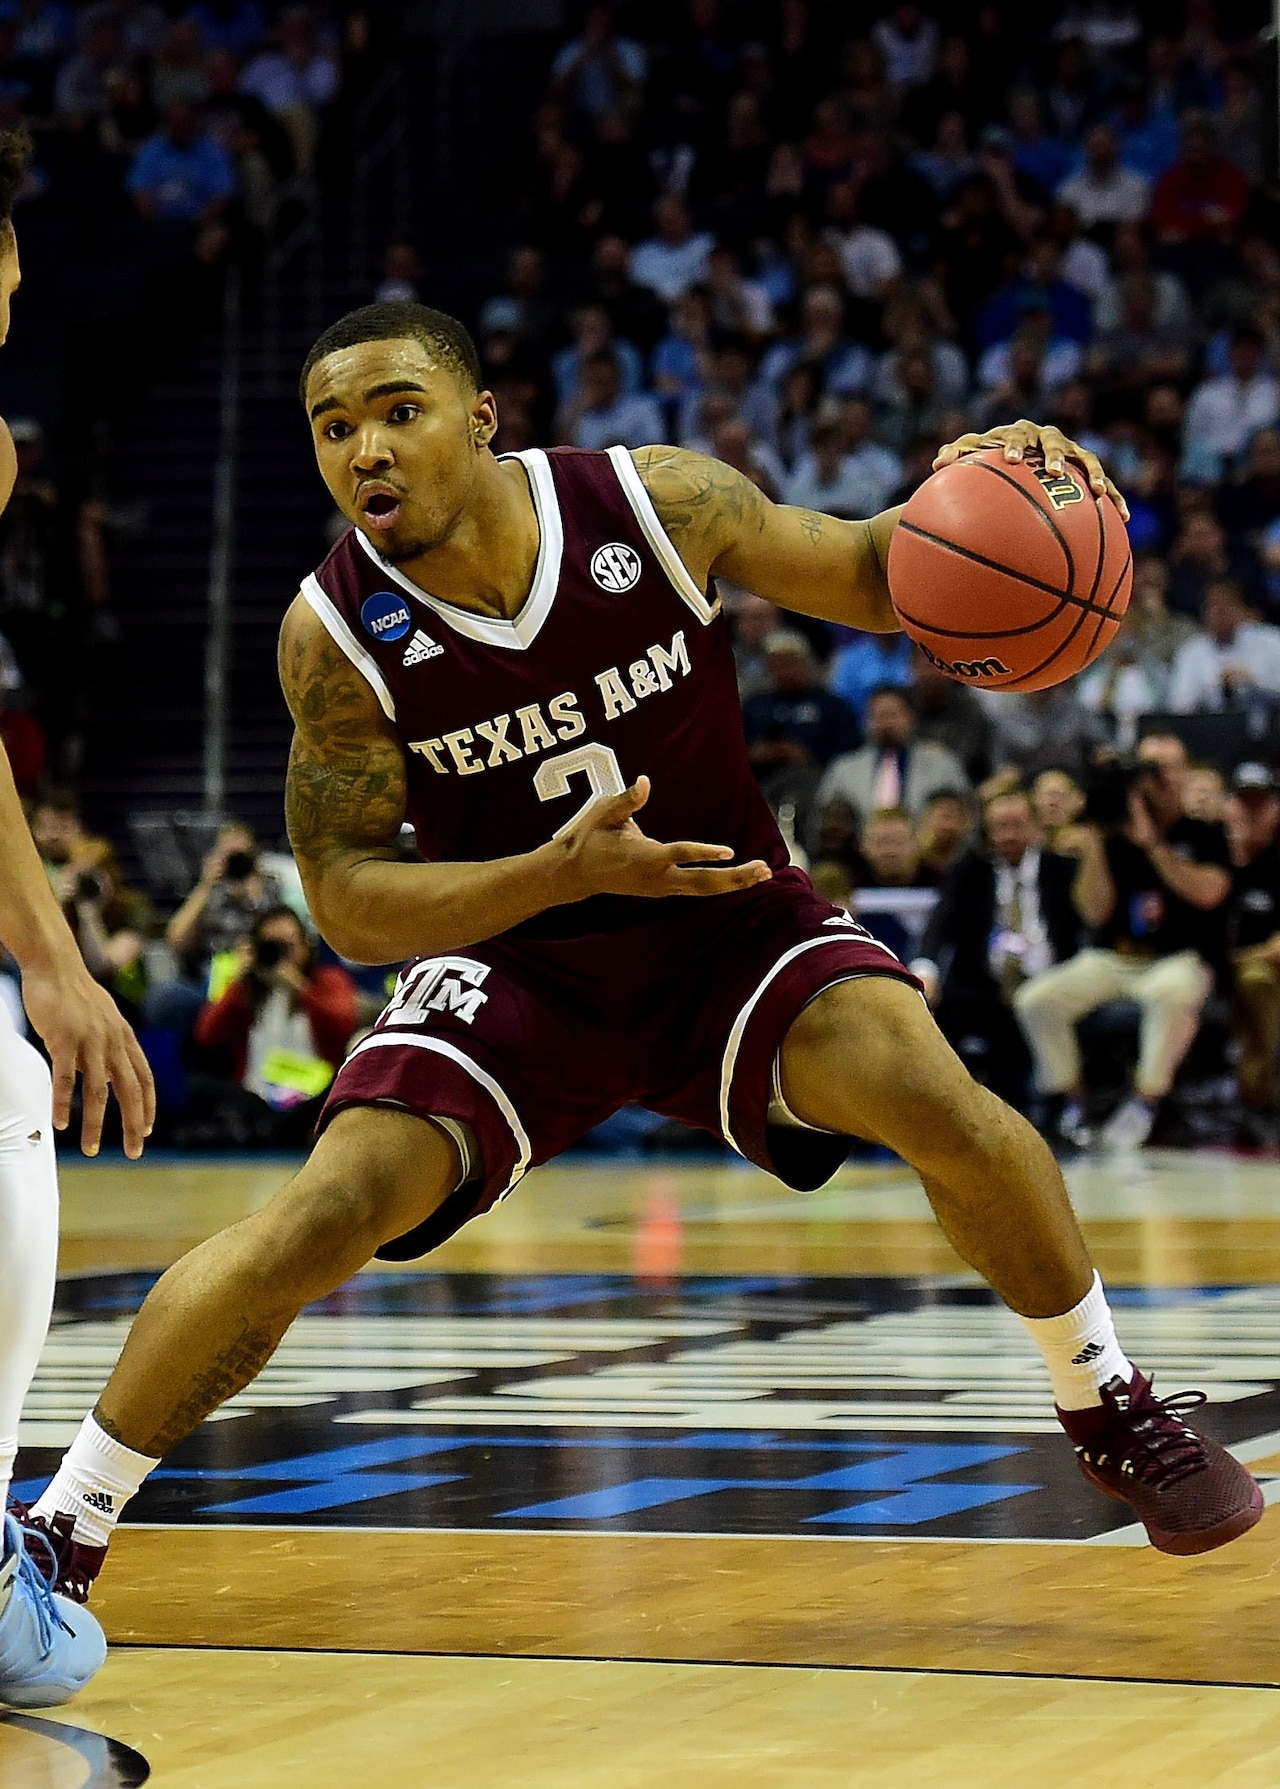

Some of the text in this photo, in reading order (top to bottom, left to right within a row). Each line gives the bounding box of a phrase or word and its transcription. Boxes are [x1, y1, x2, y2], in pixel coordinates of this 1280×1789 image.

[595, 546, 637, 589] SEC
[371, 608, 409, 634] NCAA
[403, 645, 445, 667] adidas
[408, 630, 691, 776] TEXAS A&M
[533, 742, 626, 840] 2
